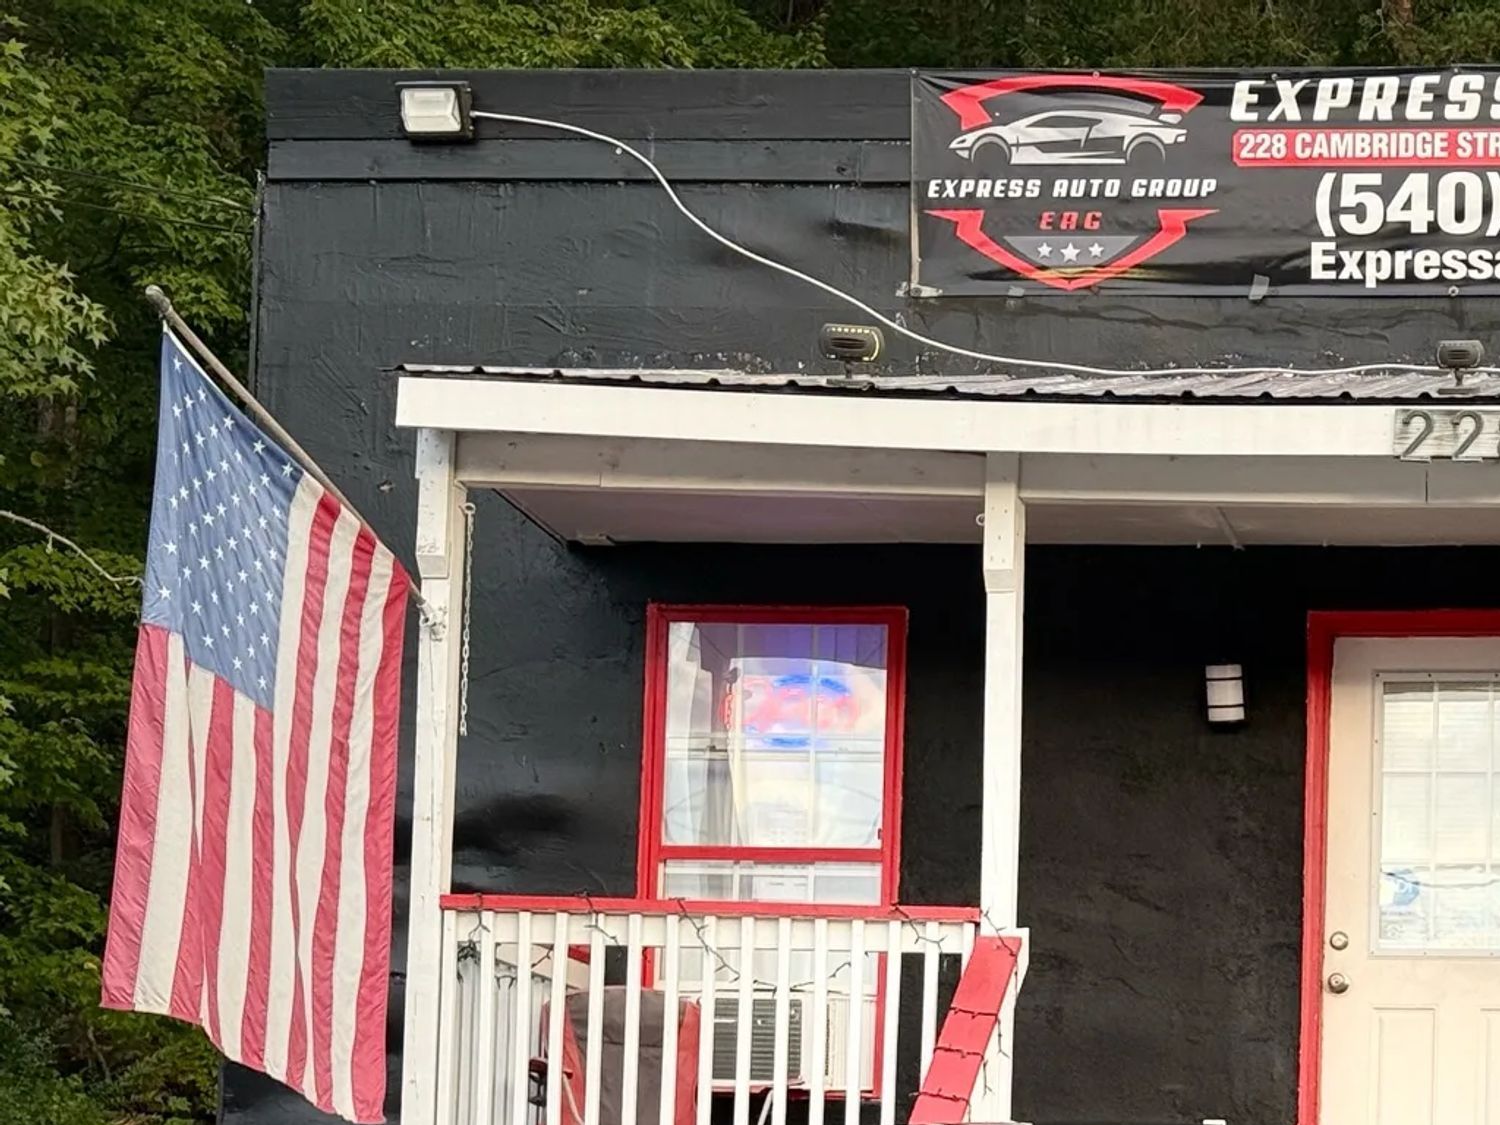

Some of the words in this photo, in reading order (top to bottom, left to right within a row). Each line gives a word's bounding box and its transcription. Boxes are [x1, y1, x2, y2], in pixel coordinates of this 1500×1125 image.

[1240, 133, 1285, 158] 228
[1295, 131, 1448, 158] CAMBRIDGE
[928, 179, 1041, 198] EXPRESS
[1053, 179, 1121, 197] AUTO
[1131, 179, 1217, 197] GROUP
